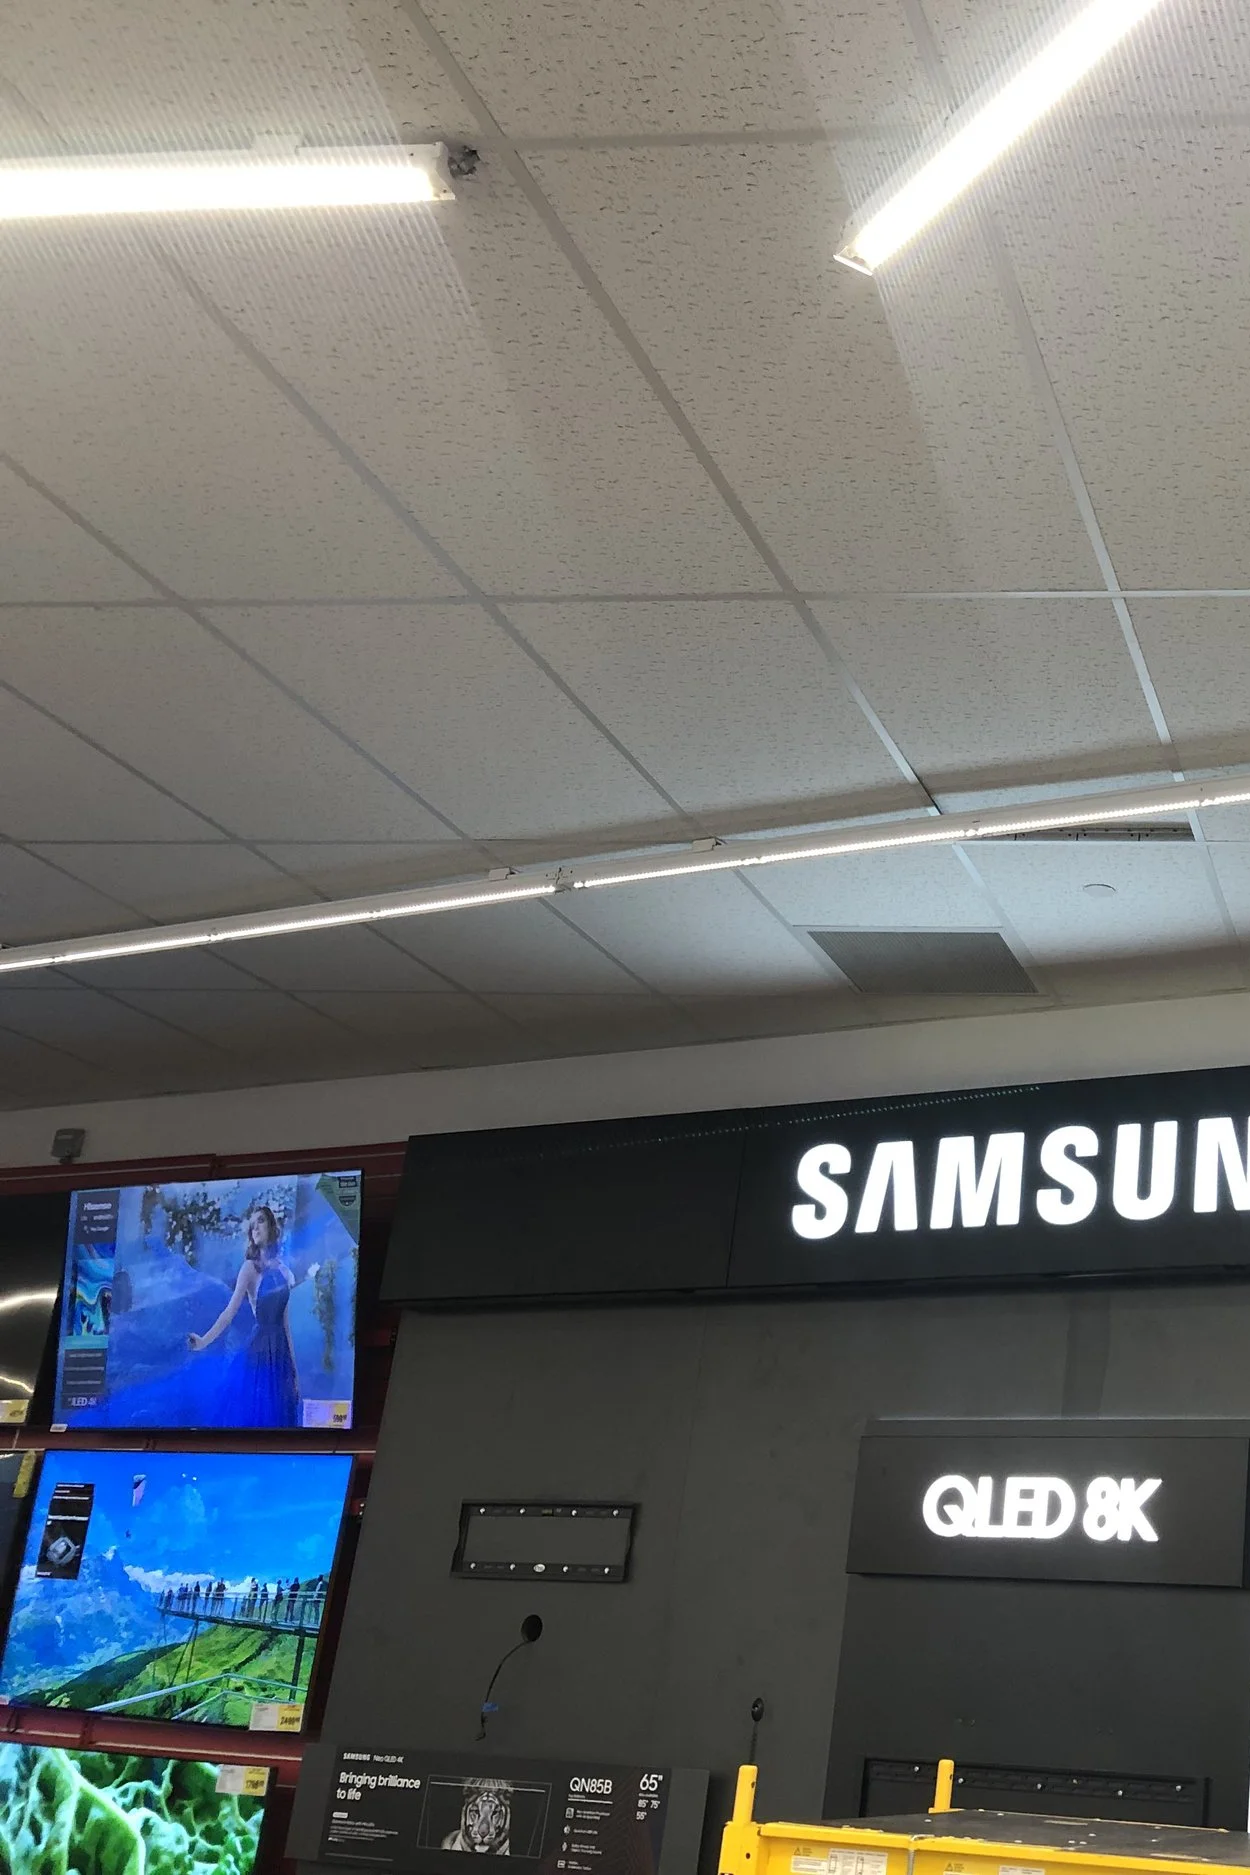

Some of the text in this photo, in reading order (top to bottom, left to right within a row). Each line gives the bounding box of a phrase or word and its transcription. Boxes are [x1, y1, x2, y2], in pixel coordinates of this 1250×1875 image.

[922, 1474, 1163, 1542] QLED 8K
[343, 1752, 371, 1761] SAMSUNG
[339, 1771, 421, 1789] Bringing brilliance
[569, 1777, 613, 1795] QN85B
[640, 1773, 663, 1791] 65"
[336, 1787, 361, 1801] to life
